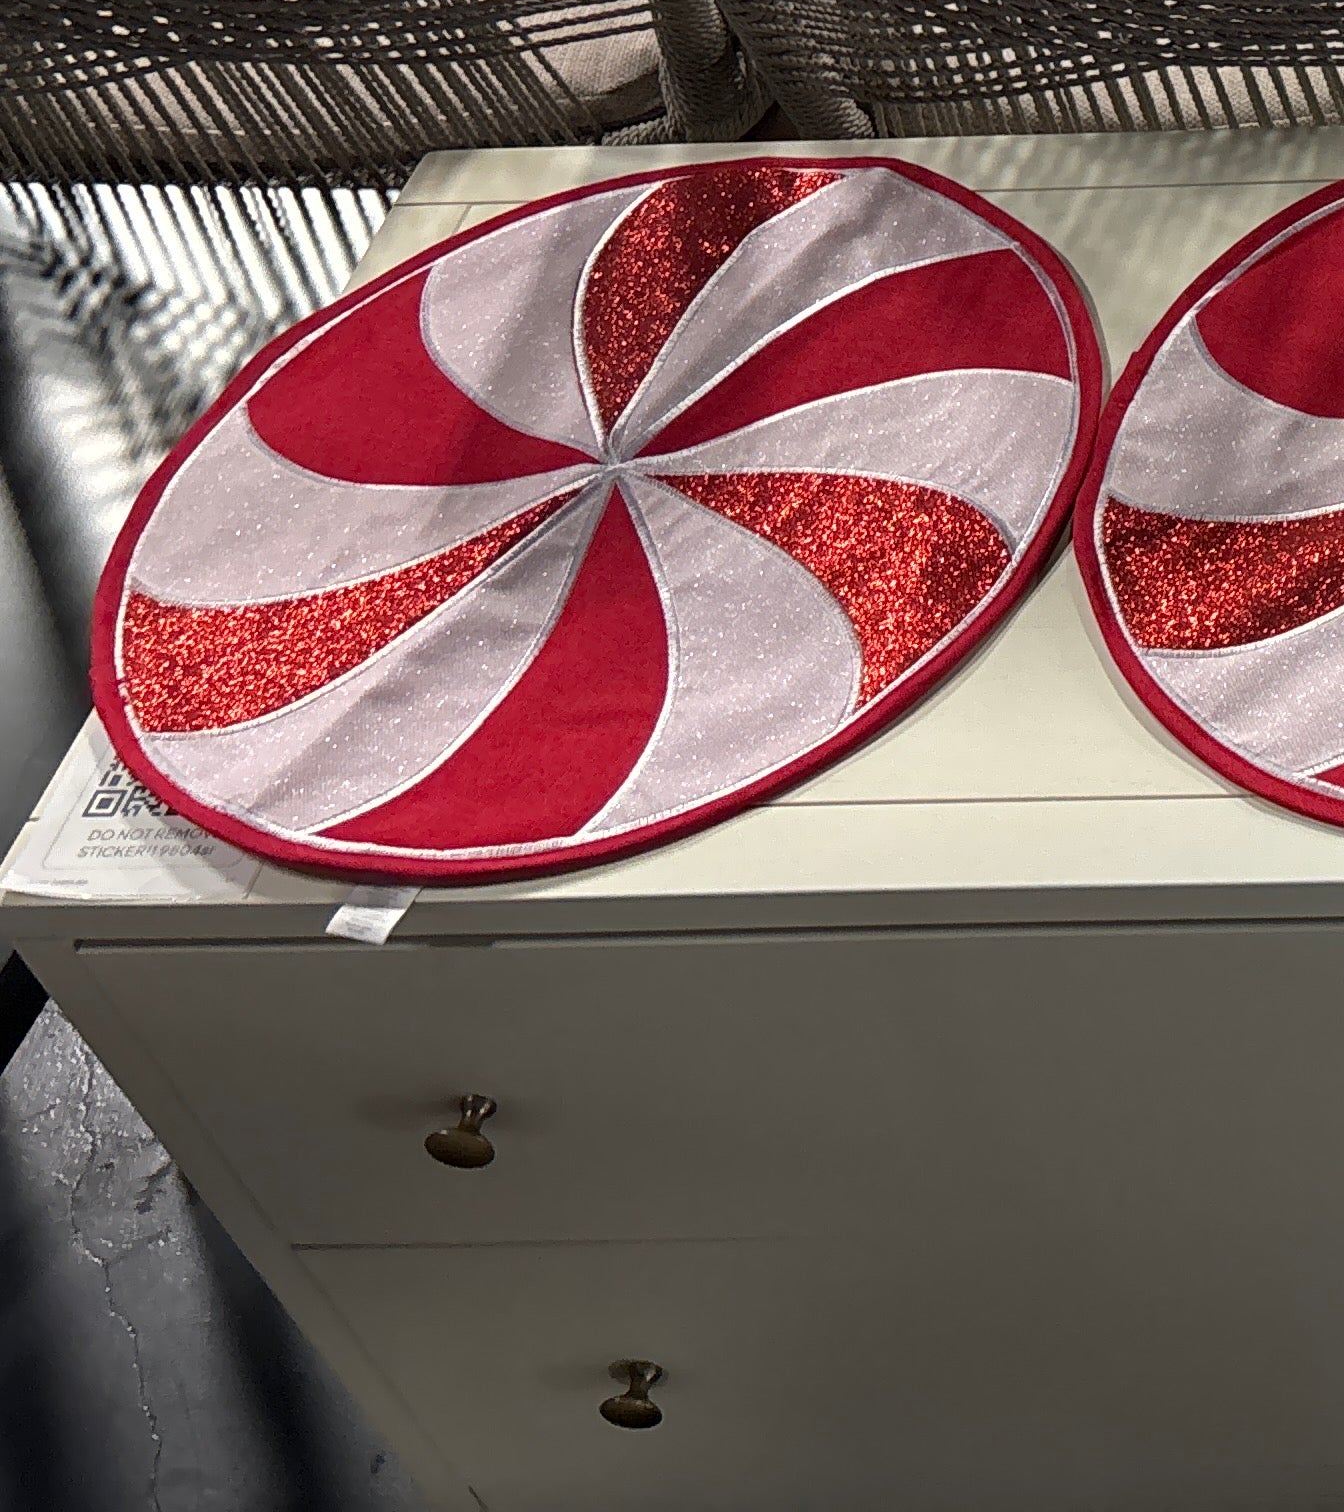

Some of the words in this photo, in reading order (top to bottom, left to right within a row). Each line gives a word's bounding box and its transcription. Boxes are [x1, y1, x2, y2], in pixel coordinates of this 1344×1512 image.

[87, 828, 115, 842] DO
[117, 826, 151, 841] NOT
[151, 824, 213, 840] REMOV
